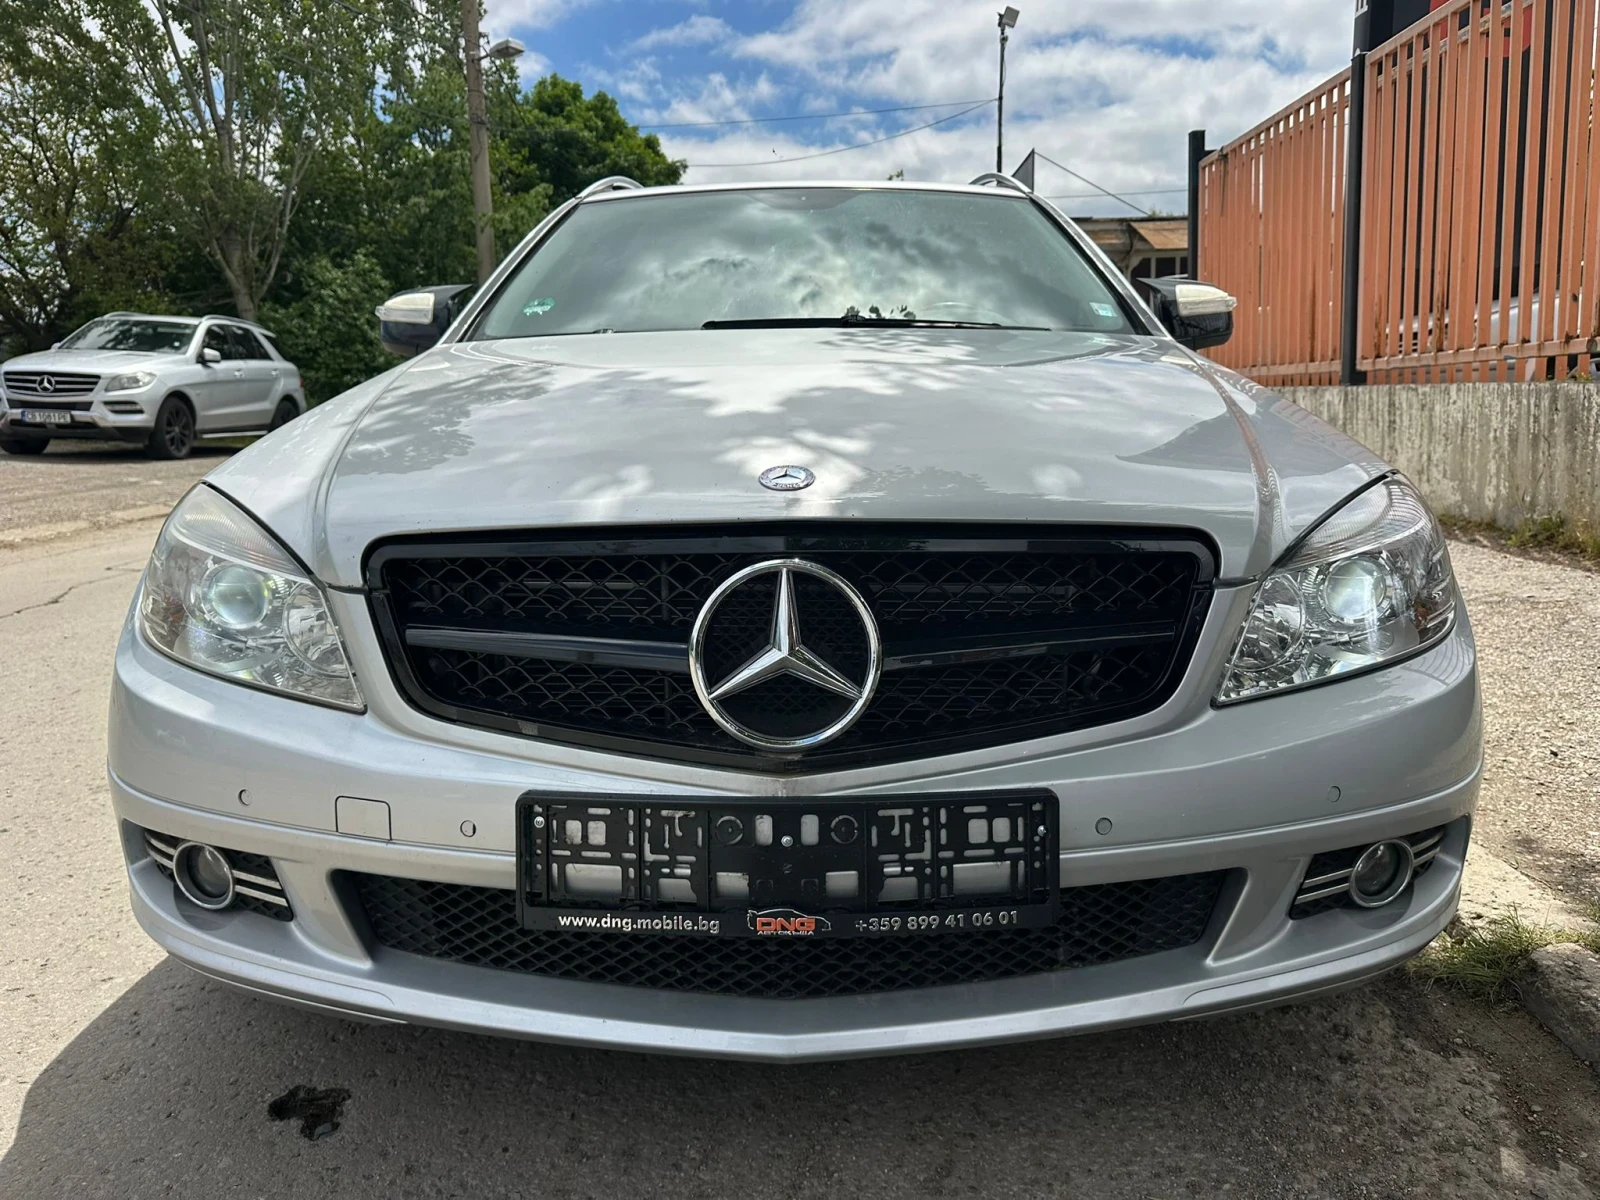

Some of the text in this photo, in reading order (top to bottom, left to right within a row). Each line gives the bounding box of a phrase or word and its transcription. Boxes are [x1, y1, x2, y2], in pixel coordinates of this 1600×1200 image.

[558, 914, 720, 934] www.dng.mobile.bg
[756, 917, 816, 931] DNG
[855, 910, 1018, 931] +359 899 41 06 01
